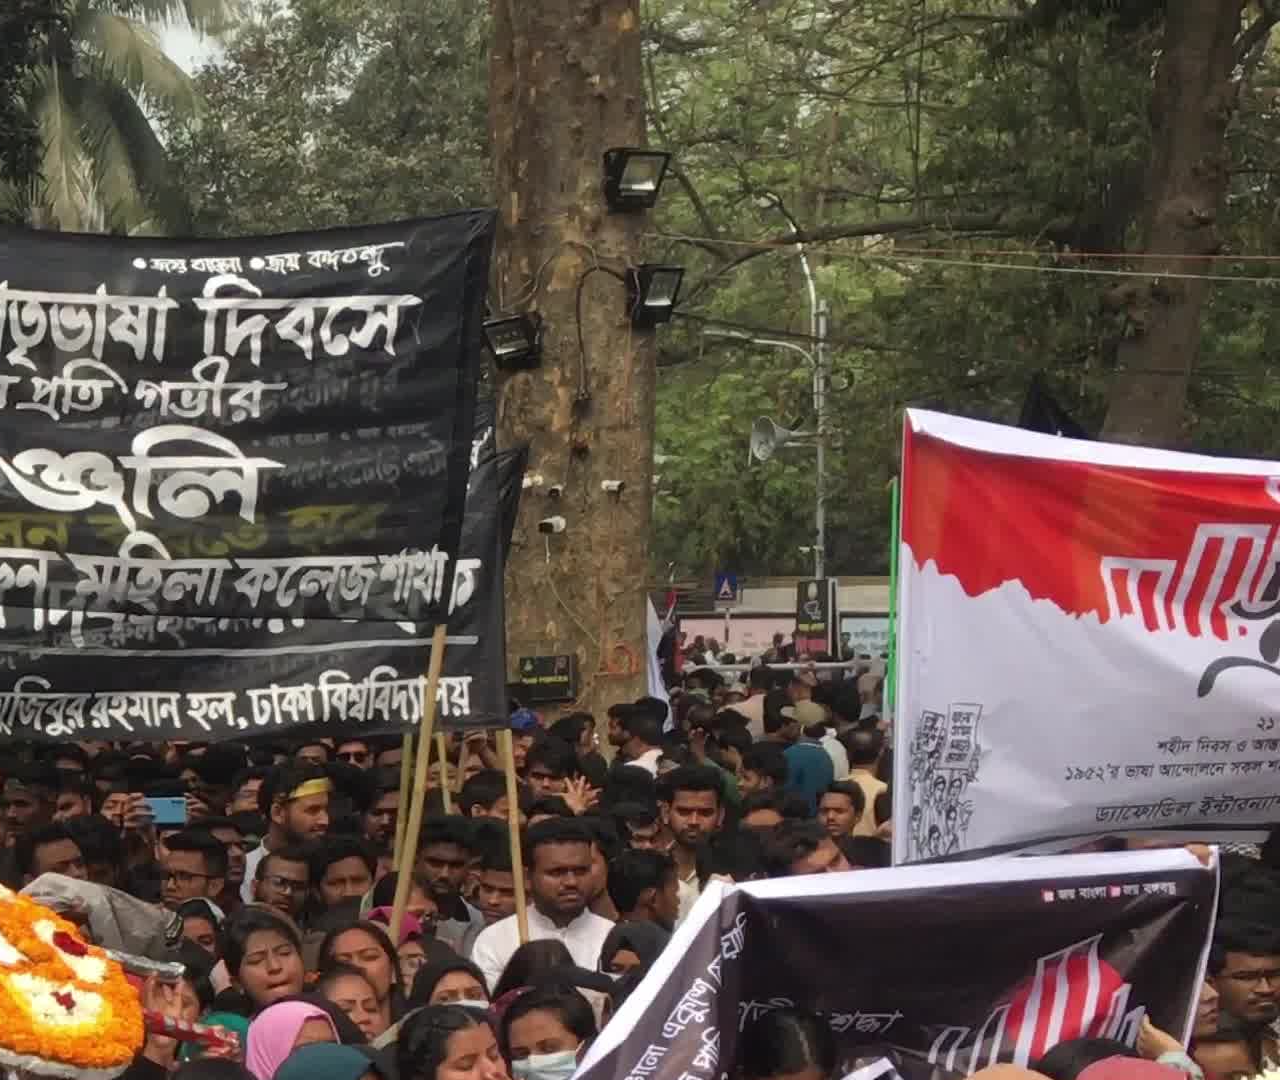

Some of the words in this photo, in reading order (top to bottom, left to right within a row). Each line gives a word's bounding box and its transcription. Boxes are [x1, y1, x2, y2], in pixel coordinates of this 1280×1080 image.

[192, 274, 424, 368] দিবসে
[16, 358, 128, 422] প্রতি
[135, 356, 288, 423] গভীর
[233, 554, 378, 608] কলেজ
[90, 690, 181, 733] রহমান
[246, 683, 319, 725] ঢাকা
